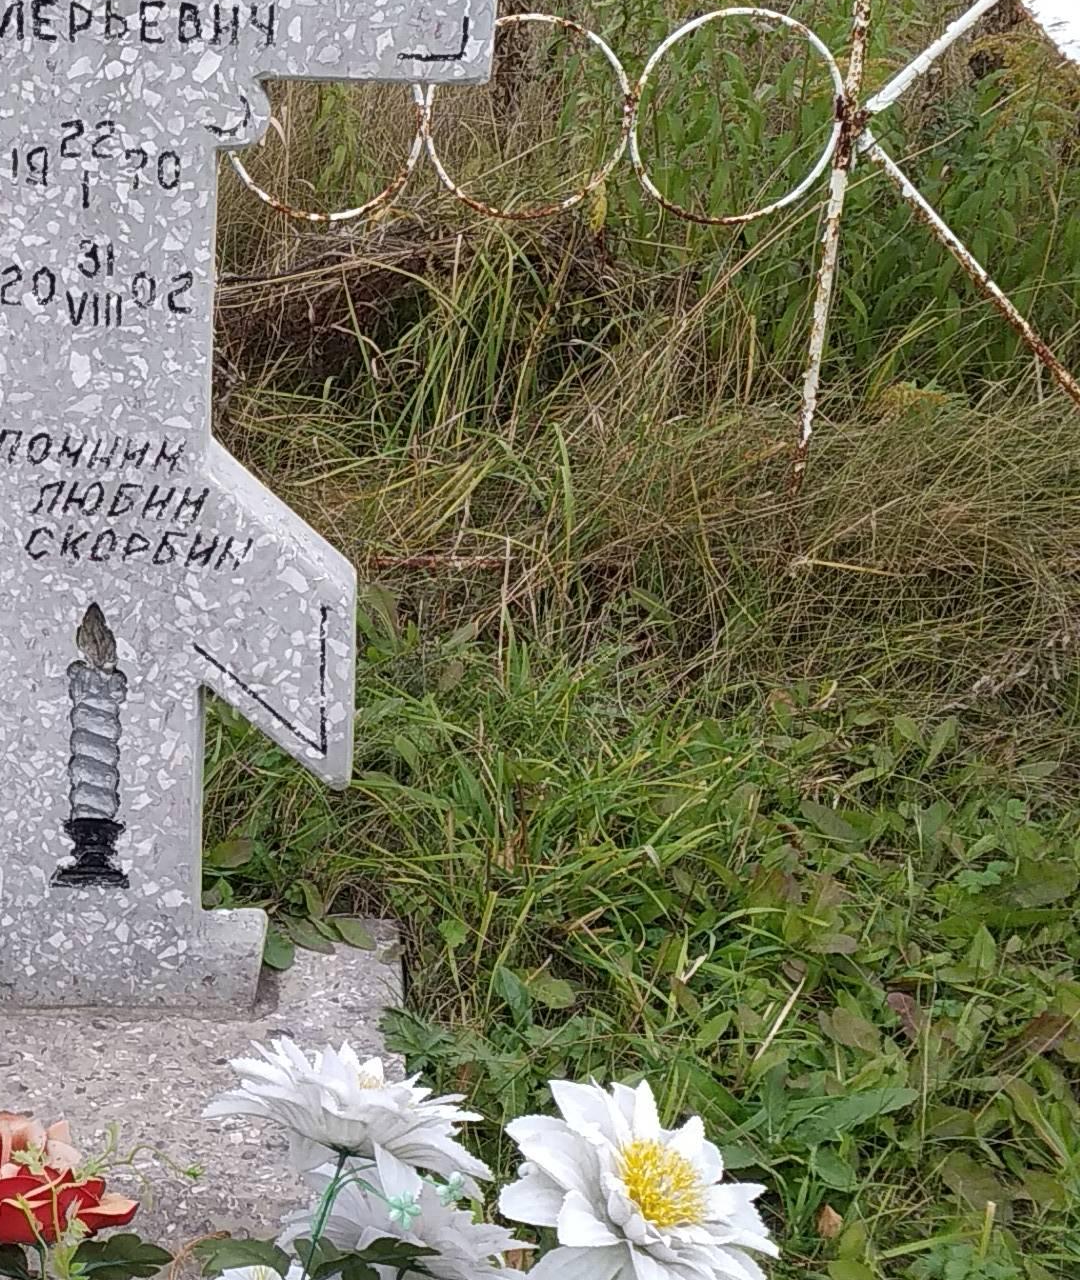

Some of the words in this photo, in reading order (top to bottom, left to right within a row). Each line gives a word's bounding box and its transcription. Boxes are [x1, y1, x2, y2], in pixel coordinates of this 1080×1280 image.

[60, 119, 116, 159] 22
[11, 146, 48, 187] 19
[124, 148, 181, 190] 70
[78, 239, 115, 278] 31
[1, 264, 56, 306] 20
[66, 290, 122, 326] VIII
[131, 271, 194, 314] 02
